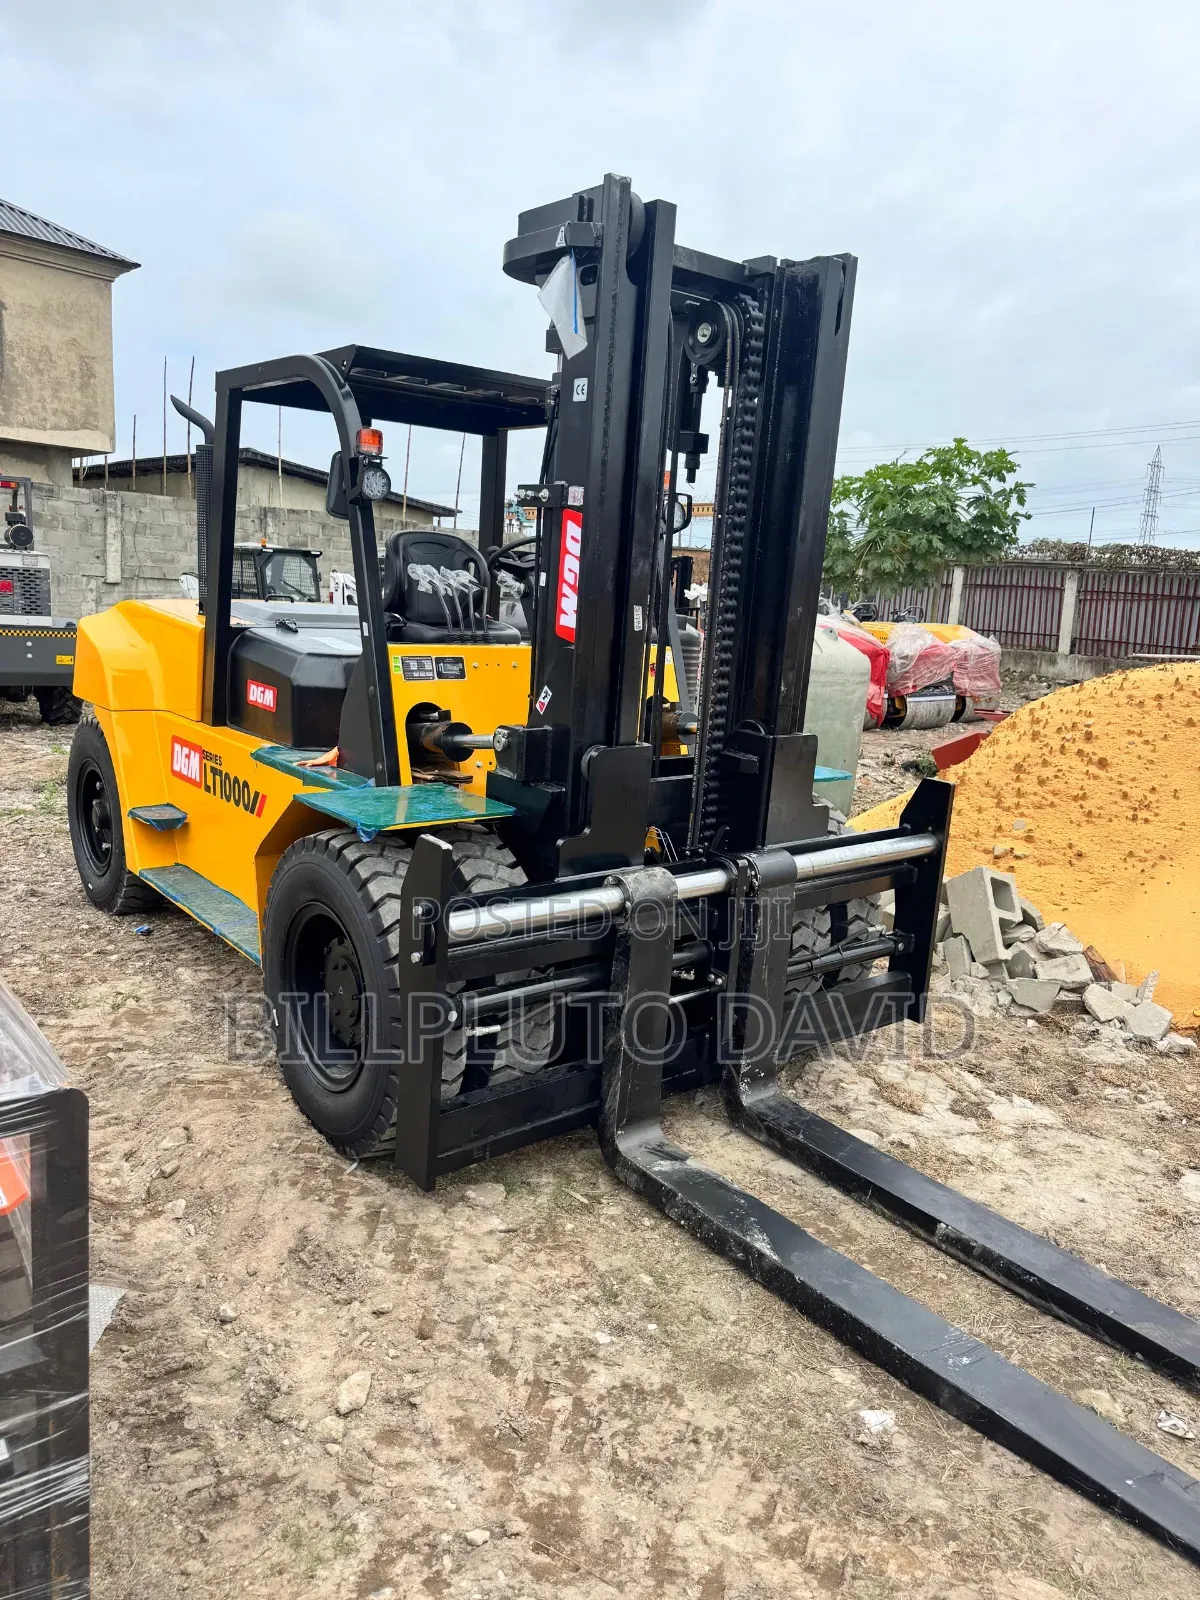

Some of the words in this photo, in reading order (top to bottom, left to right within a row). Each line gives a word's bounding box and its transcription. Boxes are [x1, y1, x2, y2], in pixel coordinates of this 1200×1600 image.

[559, 519, 582, 629] DGM
[249, 684, 274, 707] DGM
[172, 742, 200, 783] DGM
[202, 749, 223, 767] SERIES
[203, 762, 251, 812] LT1000
